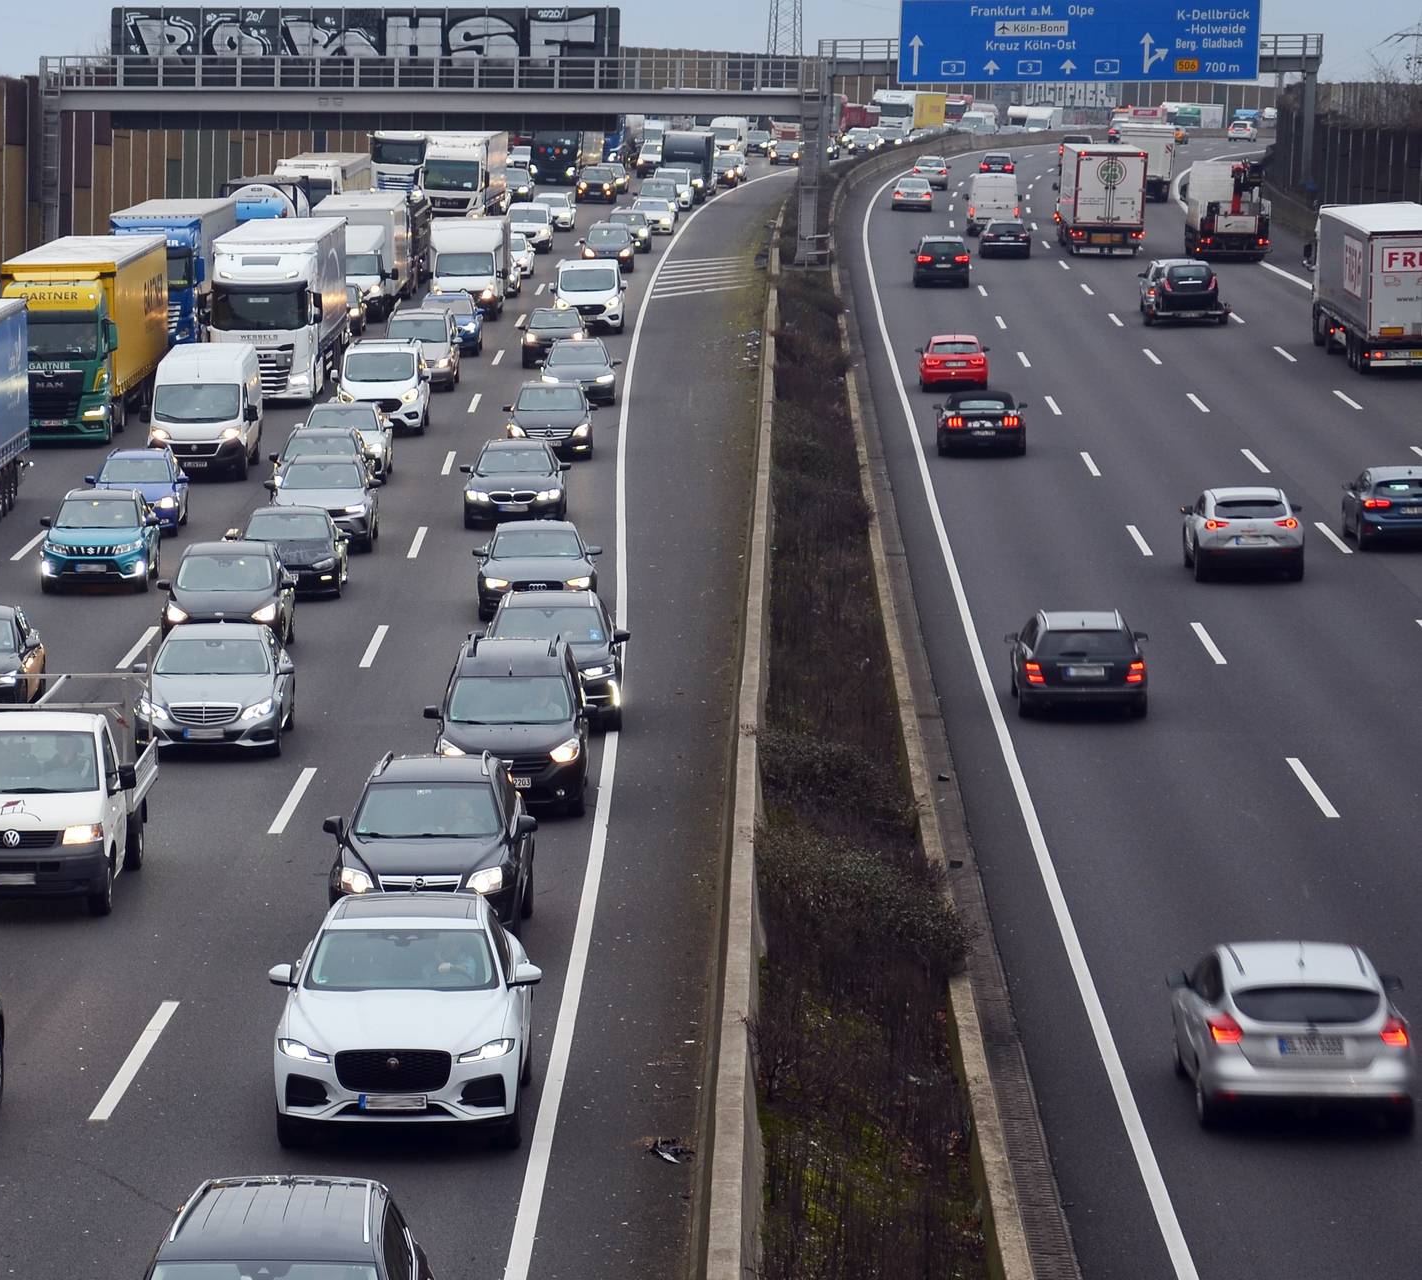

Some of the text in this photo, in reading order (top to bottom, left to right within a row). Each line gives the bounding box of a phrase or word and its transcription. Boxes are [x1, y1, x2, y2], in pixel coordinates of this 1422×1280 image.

[970, 5, 1026, 17] Frankfurt
[1067, 4, 1095, 18] Olpe
[1177, 8, 1251, 20] K-Dellbrück
[1013, 23, 1065, 33] Köln-Bonn
[985, 39, 1077, 51] Kreuz Köln-Ost
[1175, 38, 1244, 51] Berg. Gladbach
[950, 63, 957, 73] 3
[1027, 63, 1033, 72] 3
[1104, 62, 1110, 72] 3
[1178, 61, 1197, 70] 506
[1205, 62, 1240, 72] 700 m
[1388, 251, 1422, 269] FR
[28, 361, 71, 371] GARTNER
[35, 381, 65, 389] MAN
